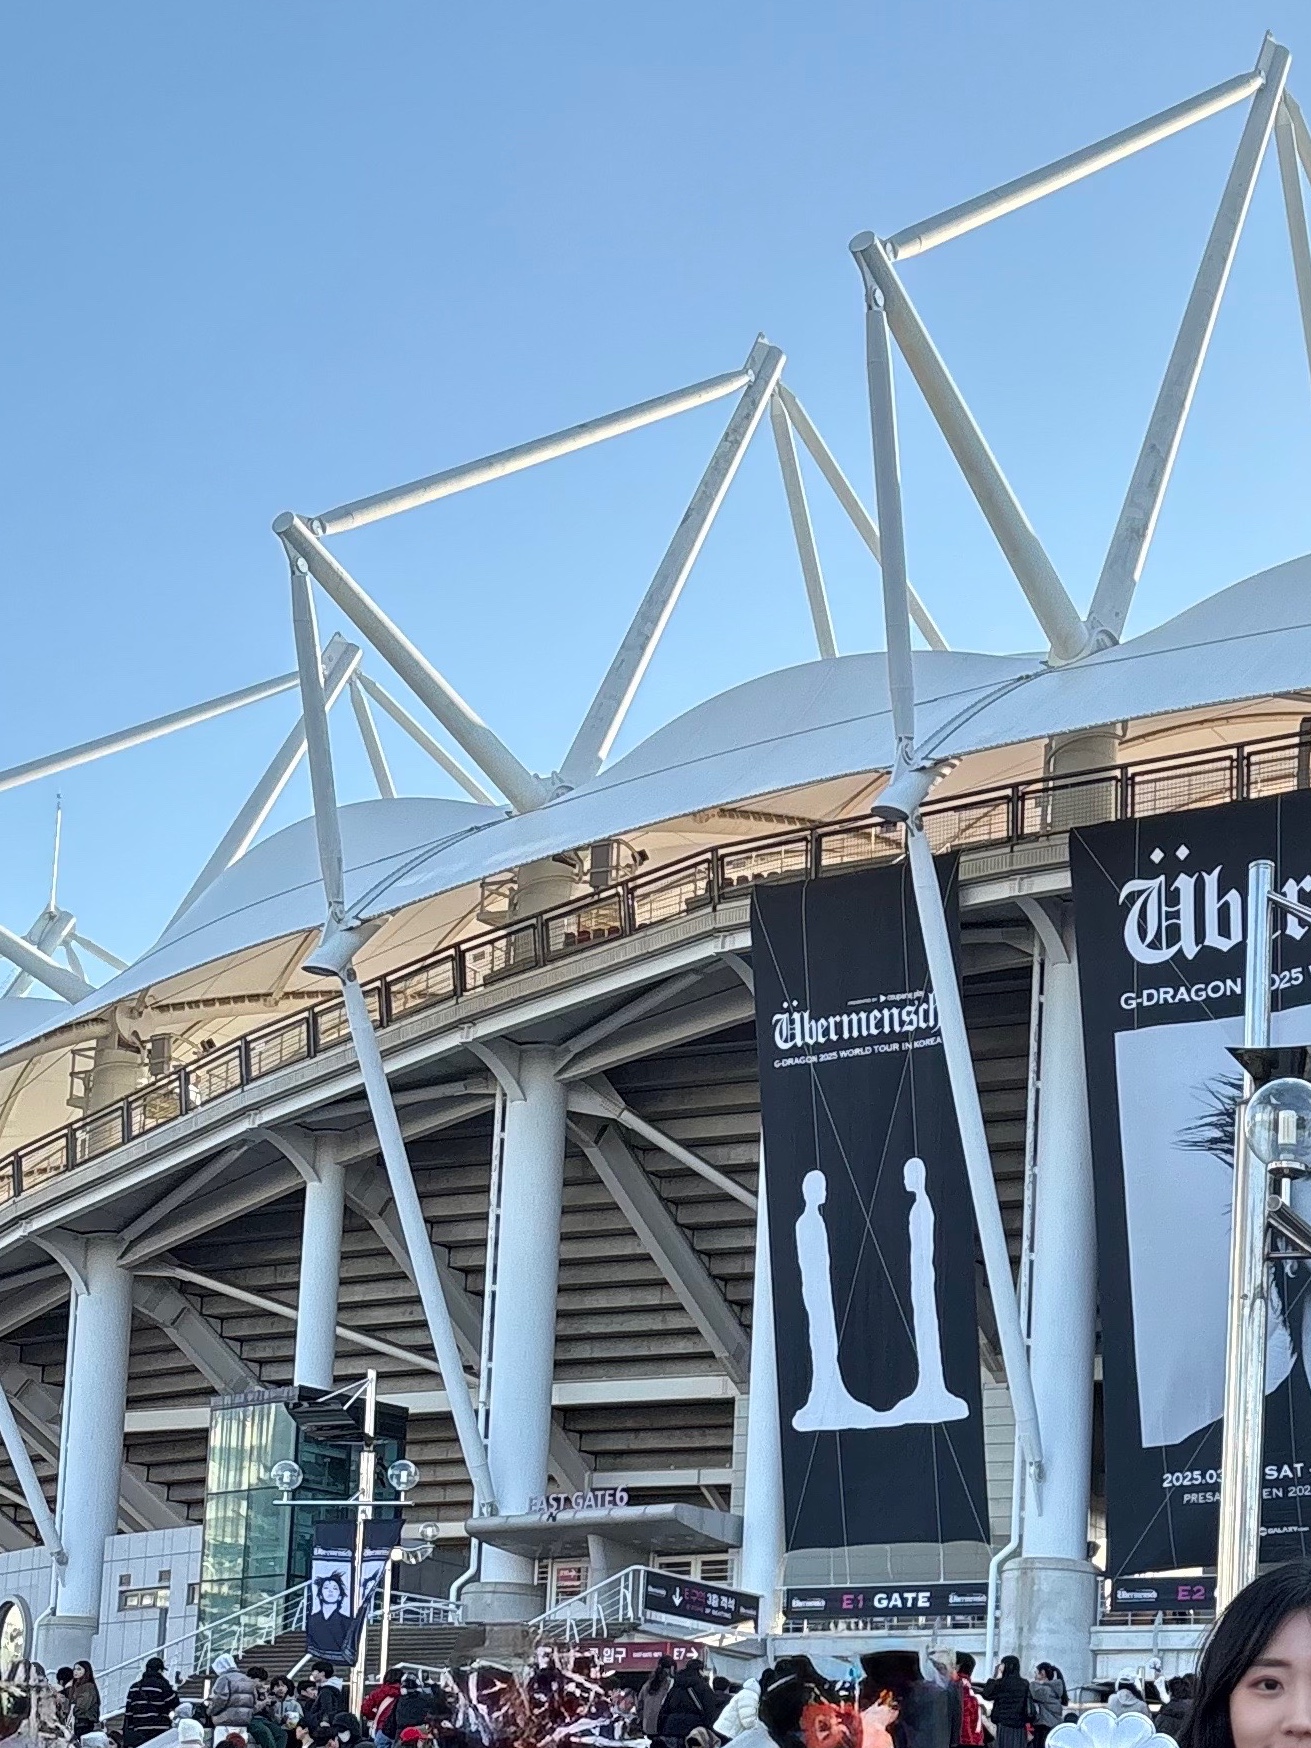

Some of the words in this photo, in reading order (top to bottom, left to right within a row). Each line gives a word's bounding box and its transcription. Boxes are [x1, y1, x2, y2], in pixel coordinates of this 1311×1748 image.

[1119, 977, 1242, 1010] G-DRAGON
[1270, 967, 1304, 990] 025
[874, 1042, 900, 1054] TOUR
[1264, 1462, 1305, 1480] SAT
[841, 1593, 864, 1609] E1
[873, 1591, 931, 1609] GATE
[1176, 1585, 1206, 1602] E2
